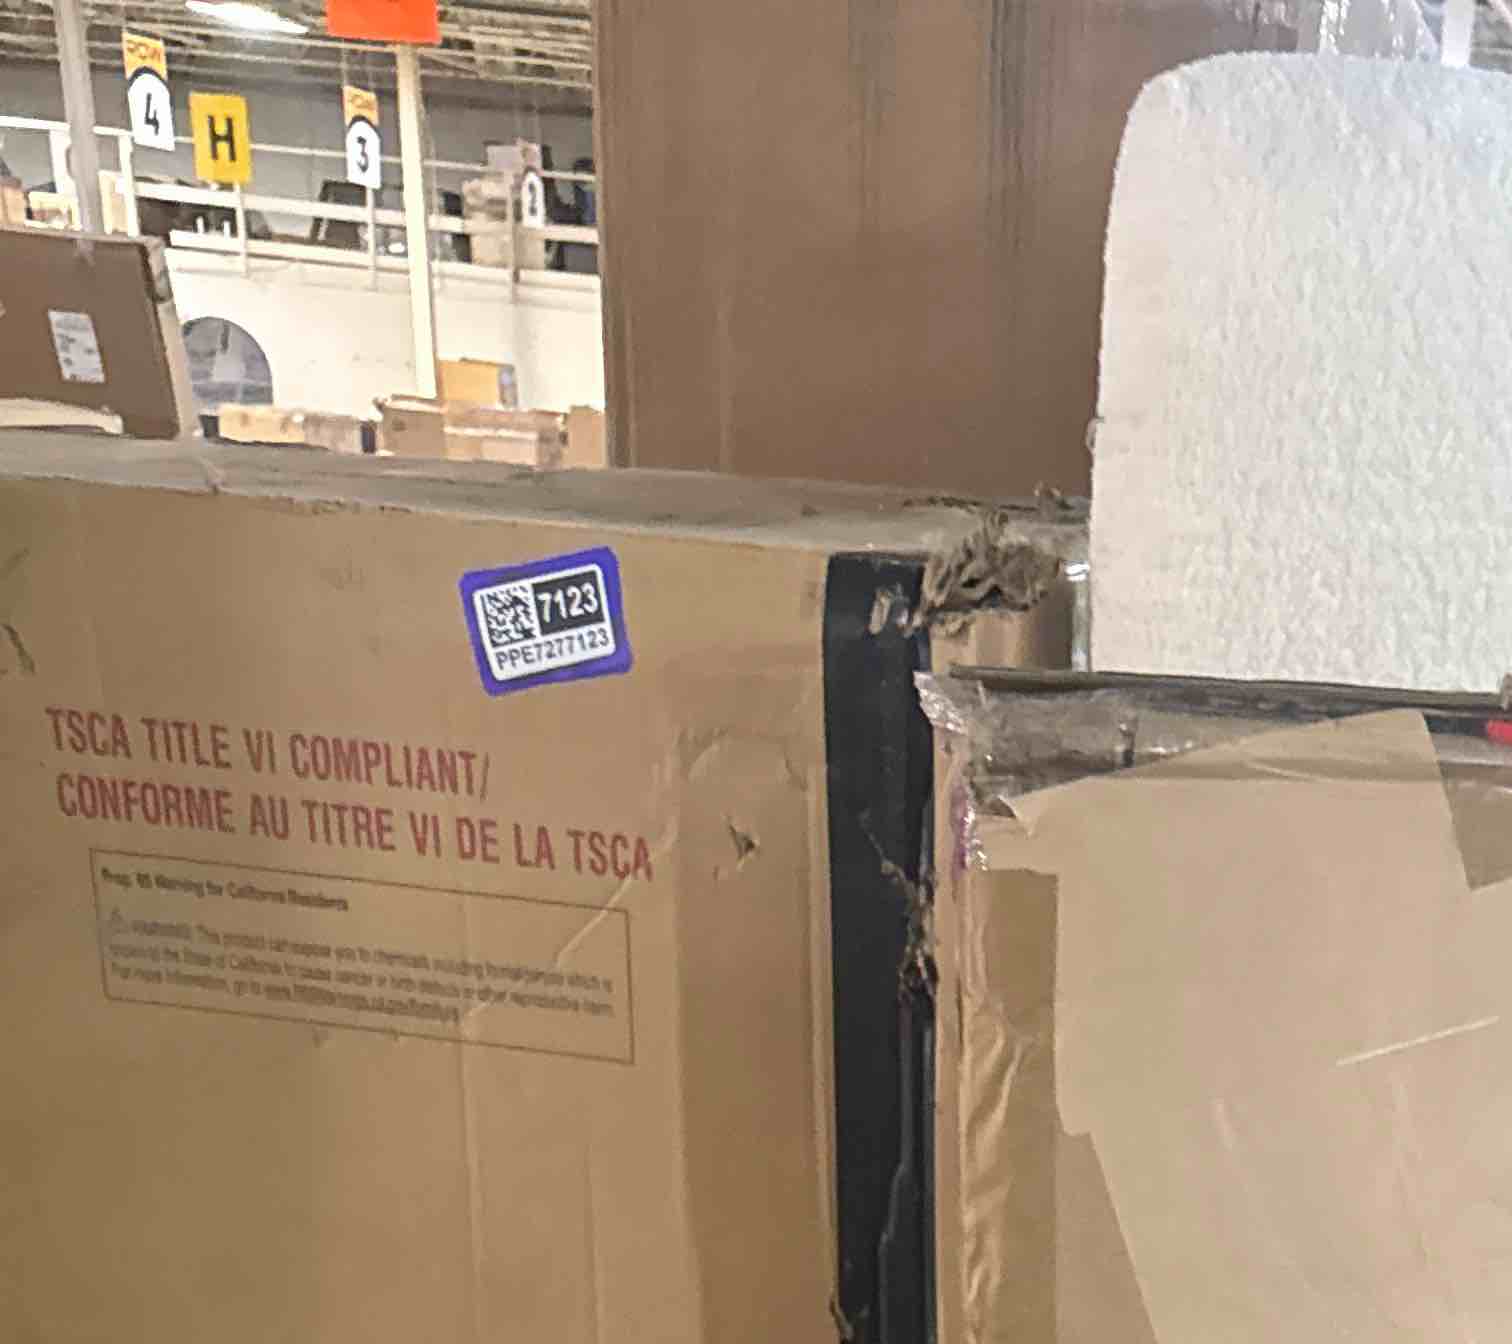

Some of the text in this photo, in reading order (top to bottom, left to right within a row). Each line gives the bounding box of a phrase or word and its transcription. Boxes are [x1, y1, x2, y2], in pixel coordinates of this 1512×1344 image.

[144, 92, 160, 137] 4
[207, 114, 238, 163] H
[356, 135, 370, 174] 3
[536, 581, 600, 623] 7123
[494, 627, 610, 671] PPE7277123
[45, 706, 490, 804] TSCA TITLE VI COMPLIANT/
[56, 772, 653, 883] CONFORME AU TITRE VI DE LA TSCA
